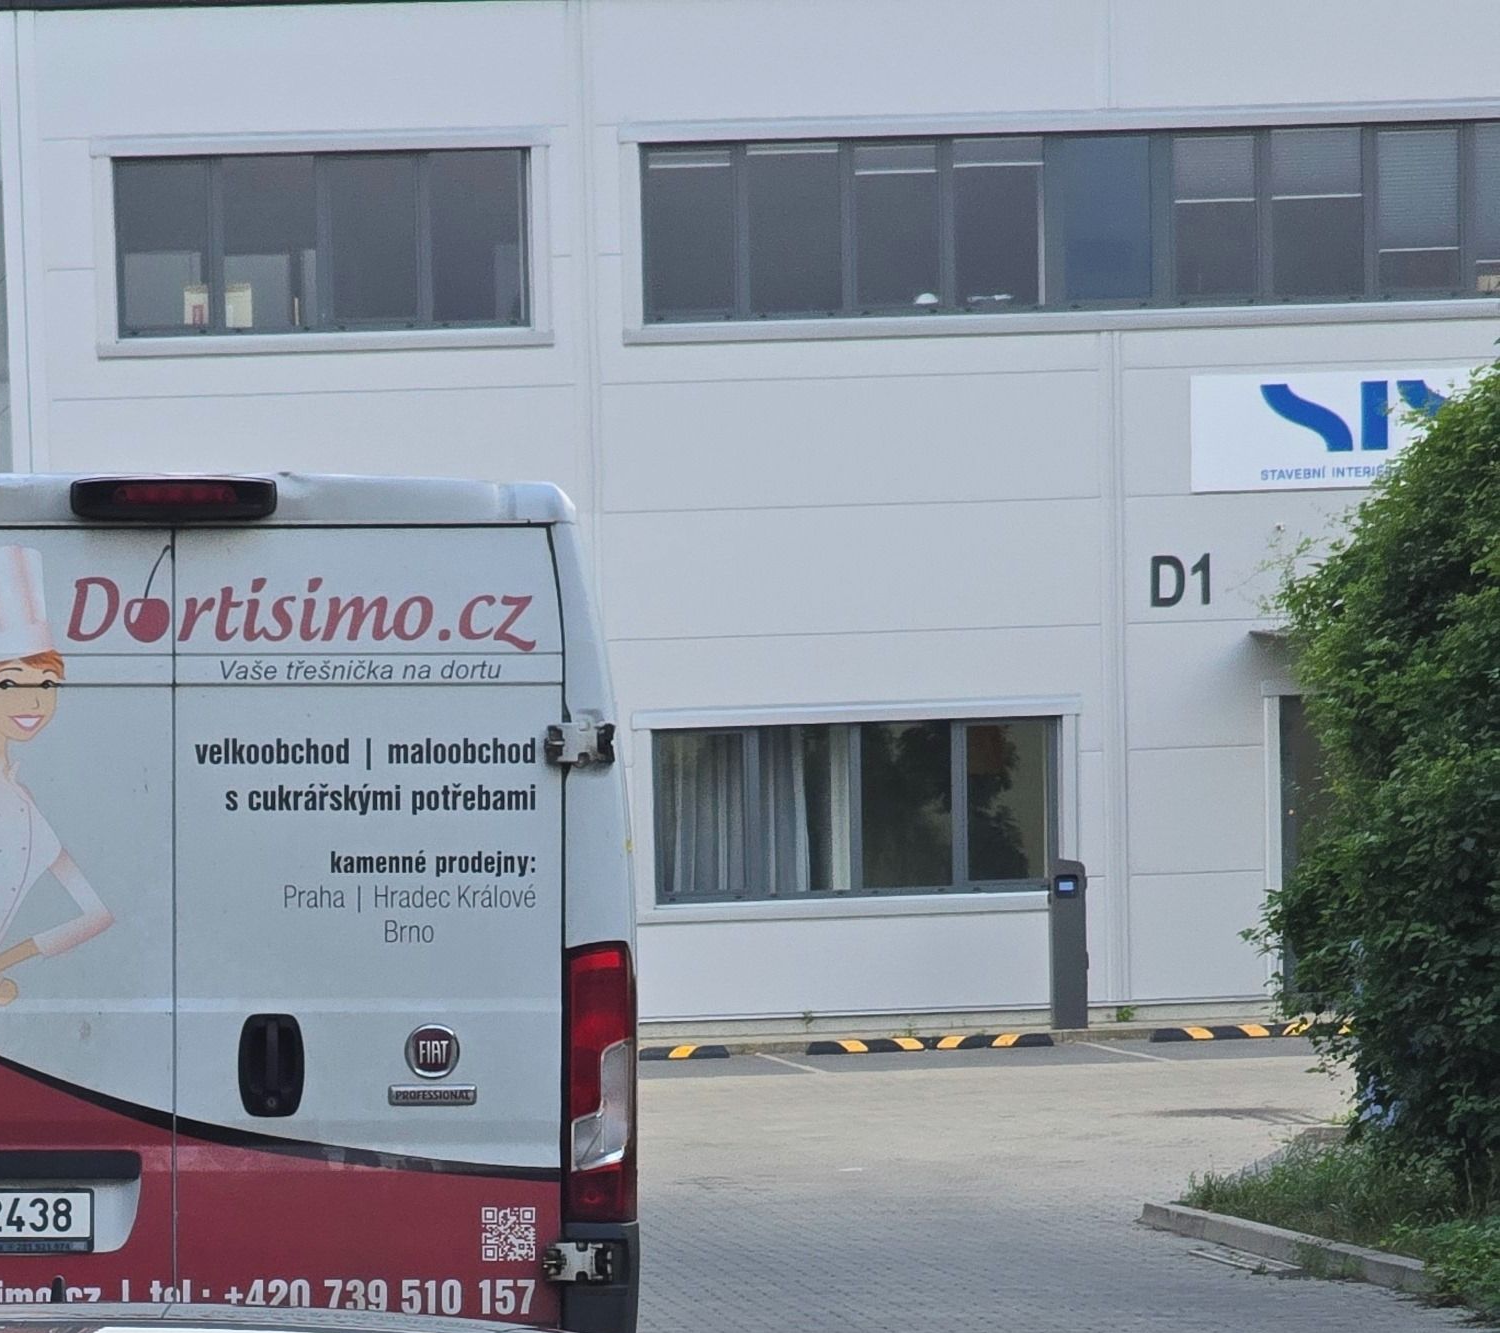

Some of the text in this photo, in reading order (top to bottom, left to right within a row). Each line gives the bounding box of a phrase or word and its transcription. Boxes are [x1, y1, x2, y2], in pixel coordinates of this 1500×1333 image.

[1260, 466, 1326, 481] STAVEBNÍ
[1150, 552, 1211, 607] D1
[67, 577, 536, 651] Dortisimo.cz
[219, 659, 502, 681] Vaše třešnička na dortu
[194, 737, 350, 765] velkoobchod
[388, 737, 536, 765] maloobchod
[225, 783, 536, 815] s cukrářskými potřebami
[330, 850, 536, 877] kamenné prodejny:
[284, 884, 346, 908] Praha
[374, 884, 451, 908] Hradec
[457, 883, 536, 908] Králové
[384, 919, 435, 943] Brno
[419, 1040, 449, 1064] FIAT
[395, 1090, 471, 1101] PROFESSIONAL
[224, 1279, 311, 1308] +420
[324, 1279, 388, 1312] 739
[401, 1279, 462, 1315] 510
[478, 1279, 536, 1315] 157
